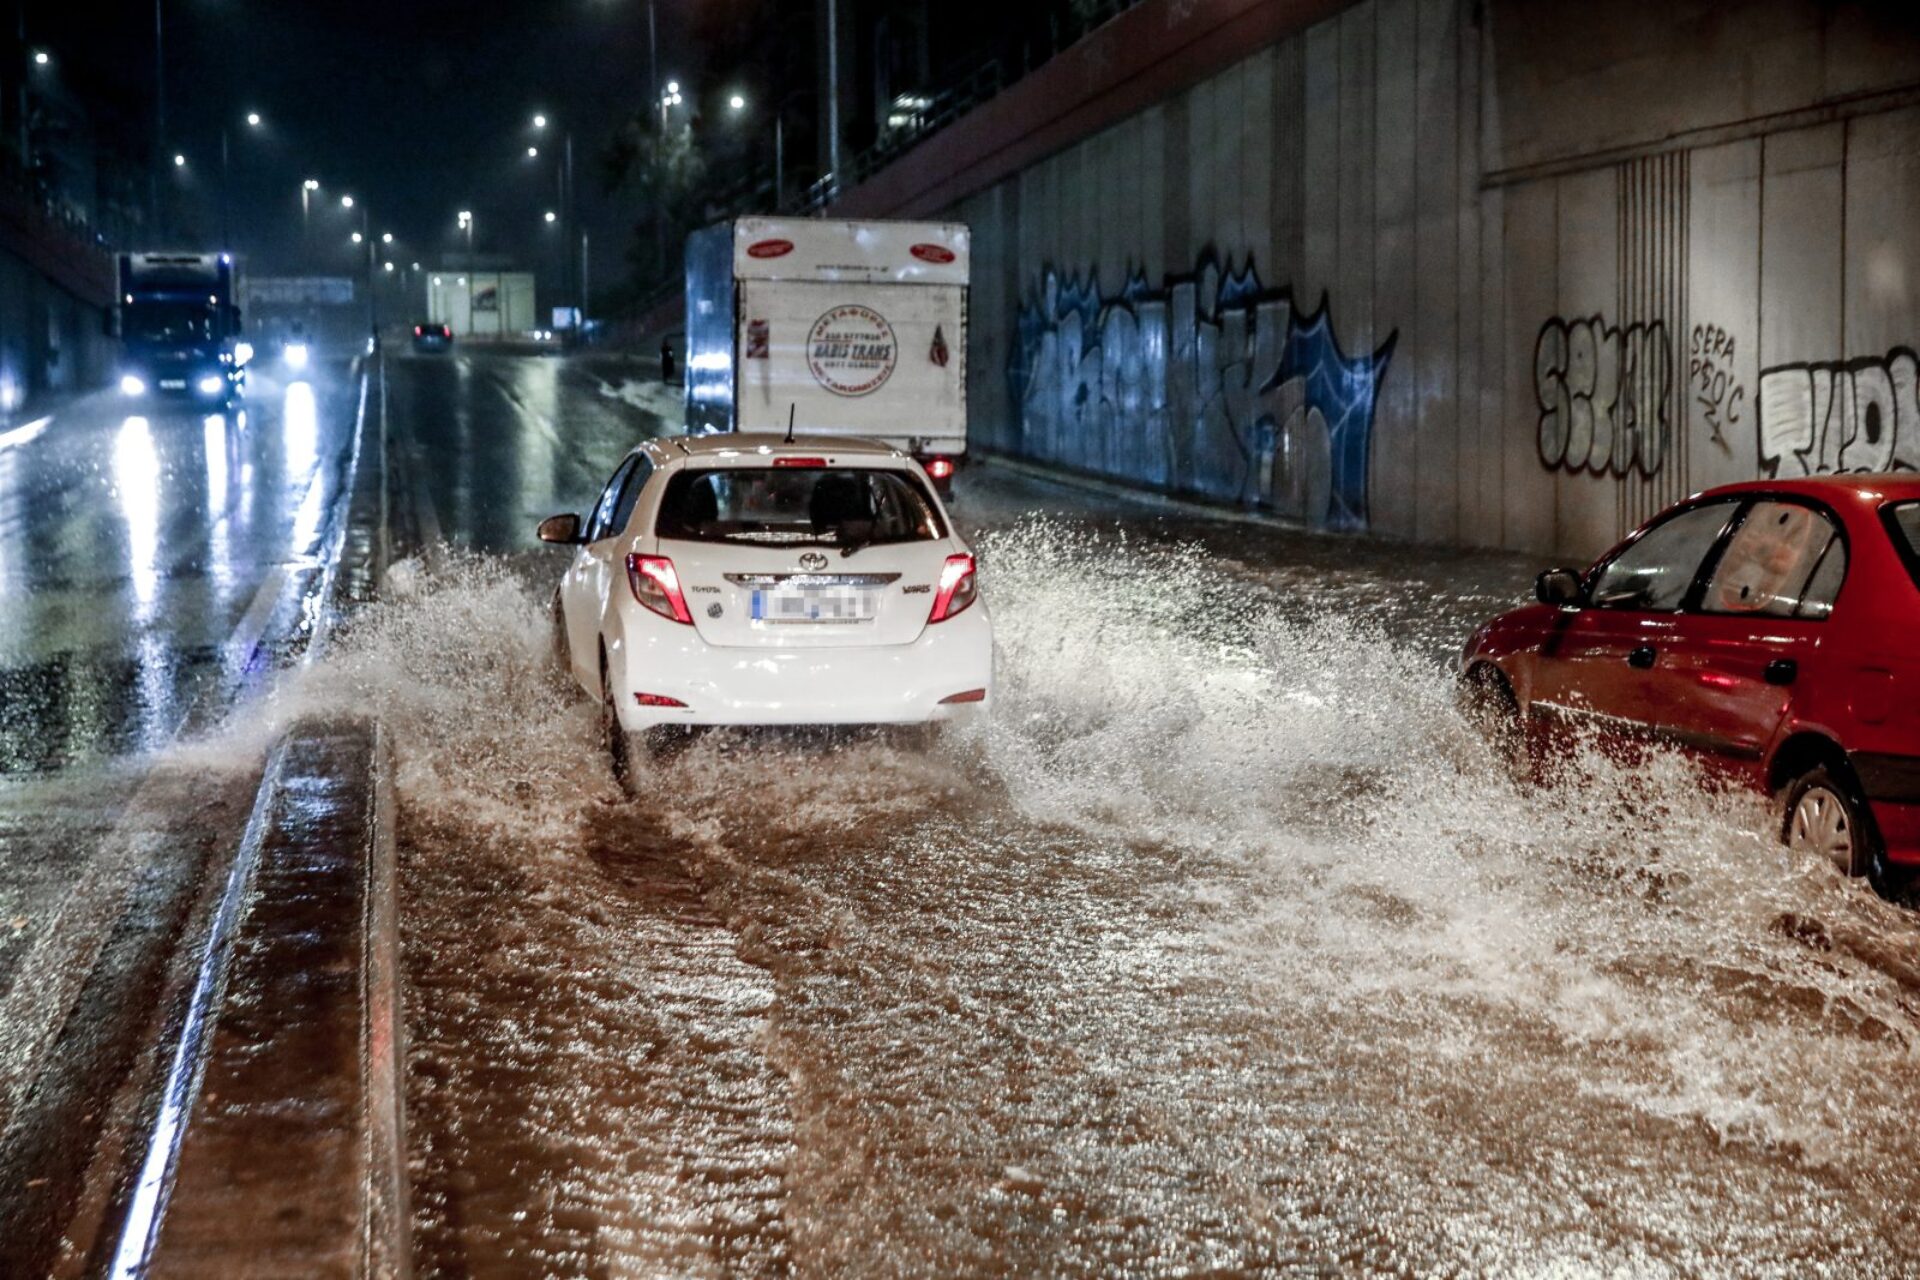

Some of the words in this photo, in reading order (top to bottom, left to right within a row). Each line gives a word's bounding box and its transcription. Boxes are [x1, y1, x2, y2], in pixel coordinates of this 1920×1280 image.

[1691, 323, 1735, 367] SERA
[851, 344, 891, 360] TRANS
[691, 585, 721, 594] TOYOTA
[902, 584, 931, 595] YARIS
